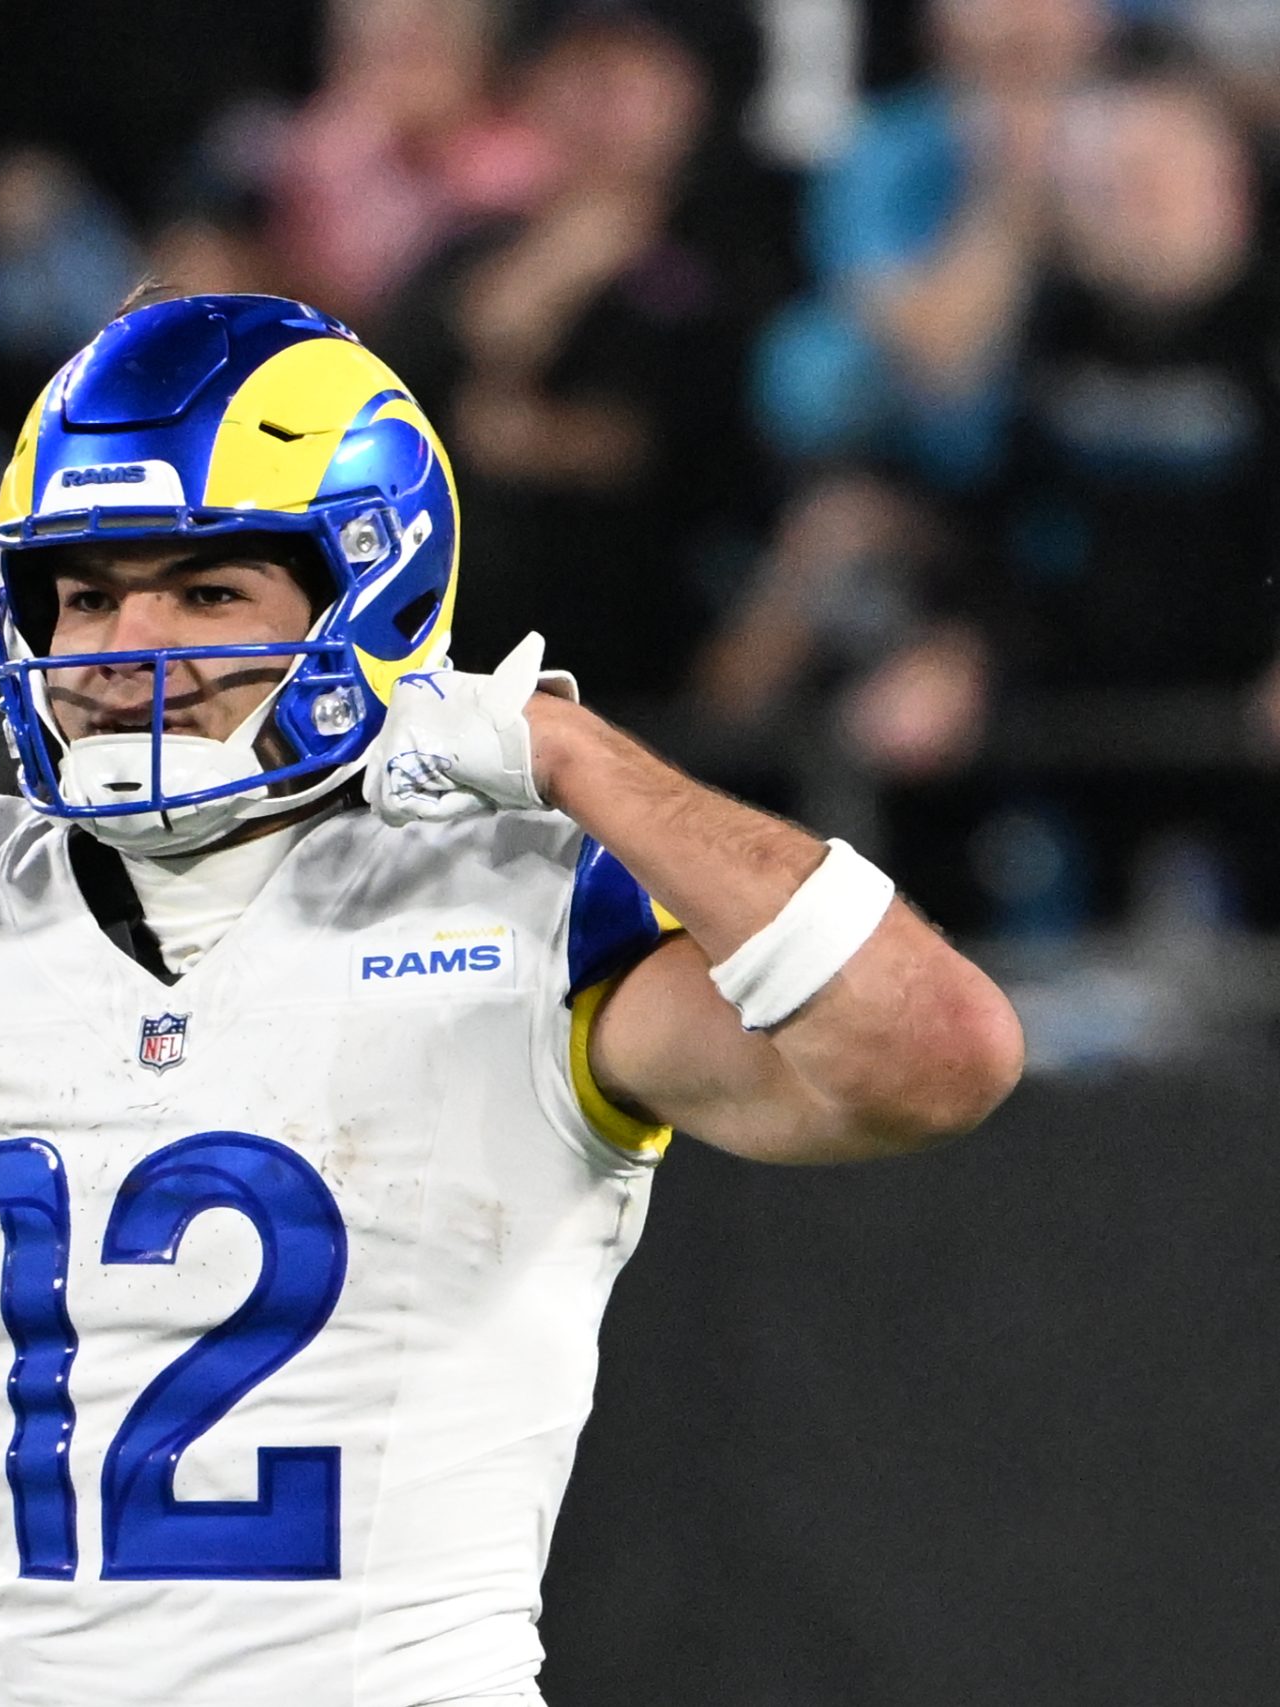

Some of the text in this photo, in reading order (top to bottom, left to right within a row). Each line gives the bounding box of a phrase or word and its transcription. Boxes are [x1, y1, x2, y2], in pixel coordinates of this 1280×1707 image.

[61, 465, 147, 488] RAMS
[362, 945, 501, 980] RAMS
[144, 1036, 178, 1062] NFL
